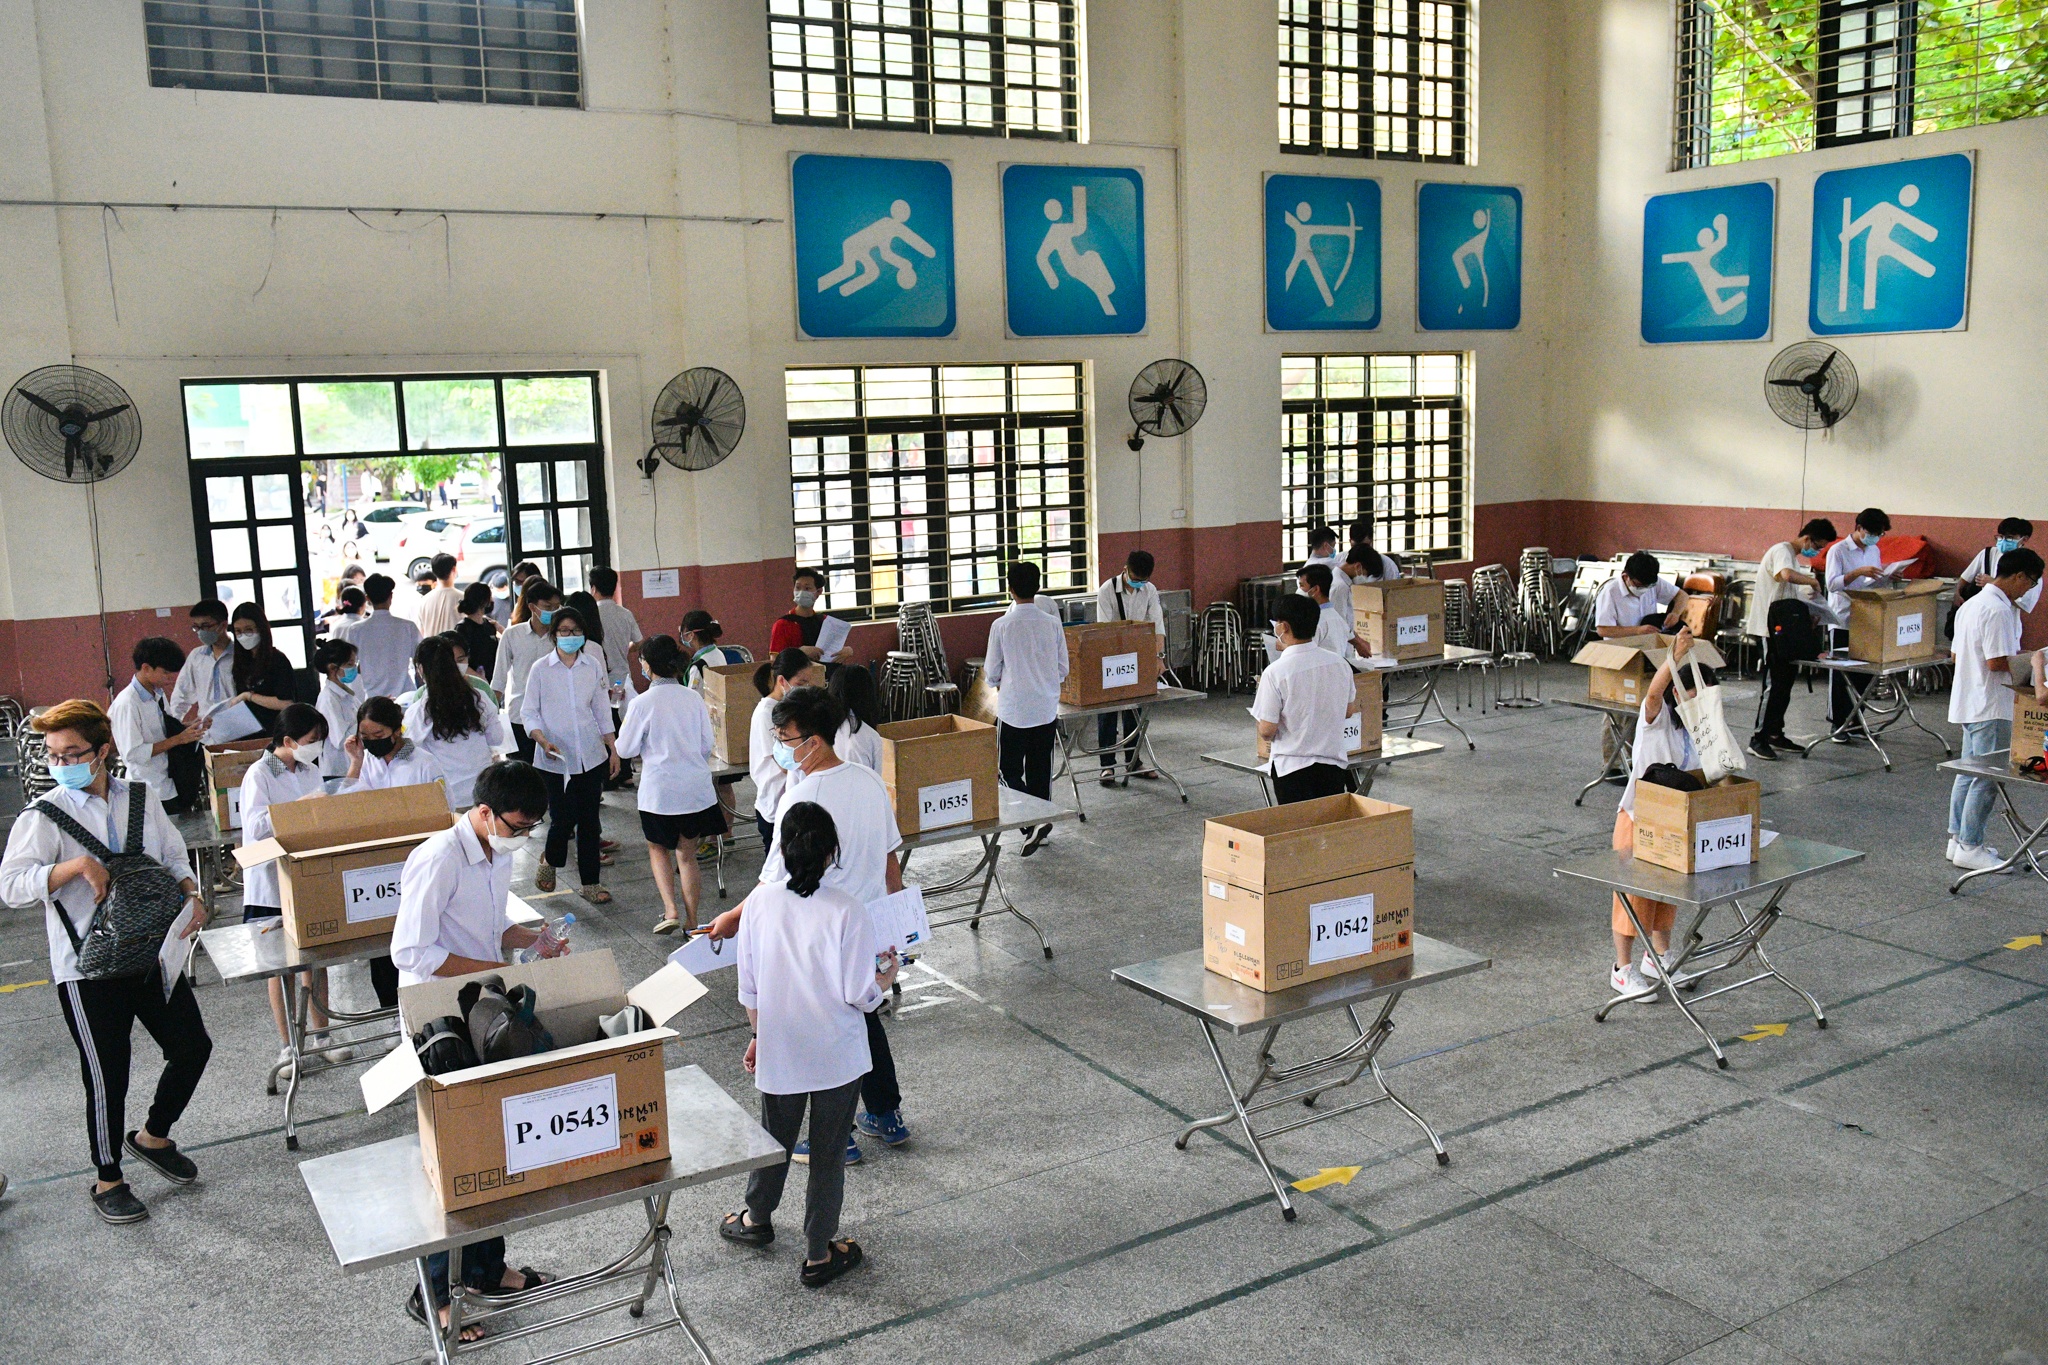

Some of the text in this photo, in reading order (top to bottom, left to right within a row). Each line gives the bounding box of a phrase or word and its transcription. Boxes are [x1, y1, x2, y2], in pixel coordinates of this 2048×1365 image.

[1356, 620, 1369, 628] PLUS
[1400, 626, 1407, 635] P.
[1408, 624, 1426, 634] 0524
[1899, 623, 1921, 635] P. 0538
[1105, 663, 1136, 677] P. 0525
[2024, 710, 2048, 721] PLUS
[923, 793, 969, 814] P. 0535
[1639, 828, 1654, 839] PLUS
[1701, 839, 1713, 853] P.
[1717, 833, 1746, 850] 0541
[352, 887, 370, 903] P.
[1316, 916, 1368, 941] P. 0542
[624, 1049, 655, 1063] 2 DOZ.
[515, 1103, 610, 1146] P. 0543
